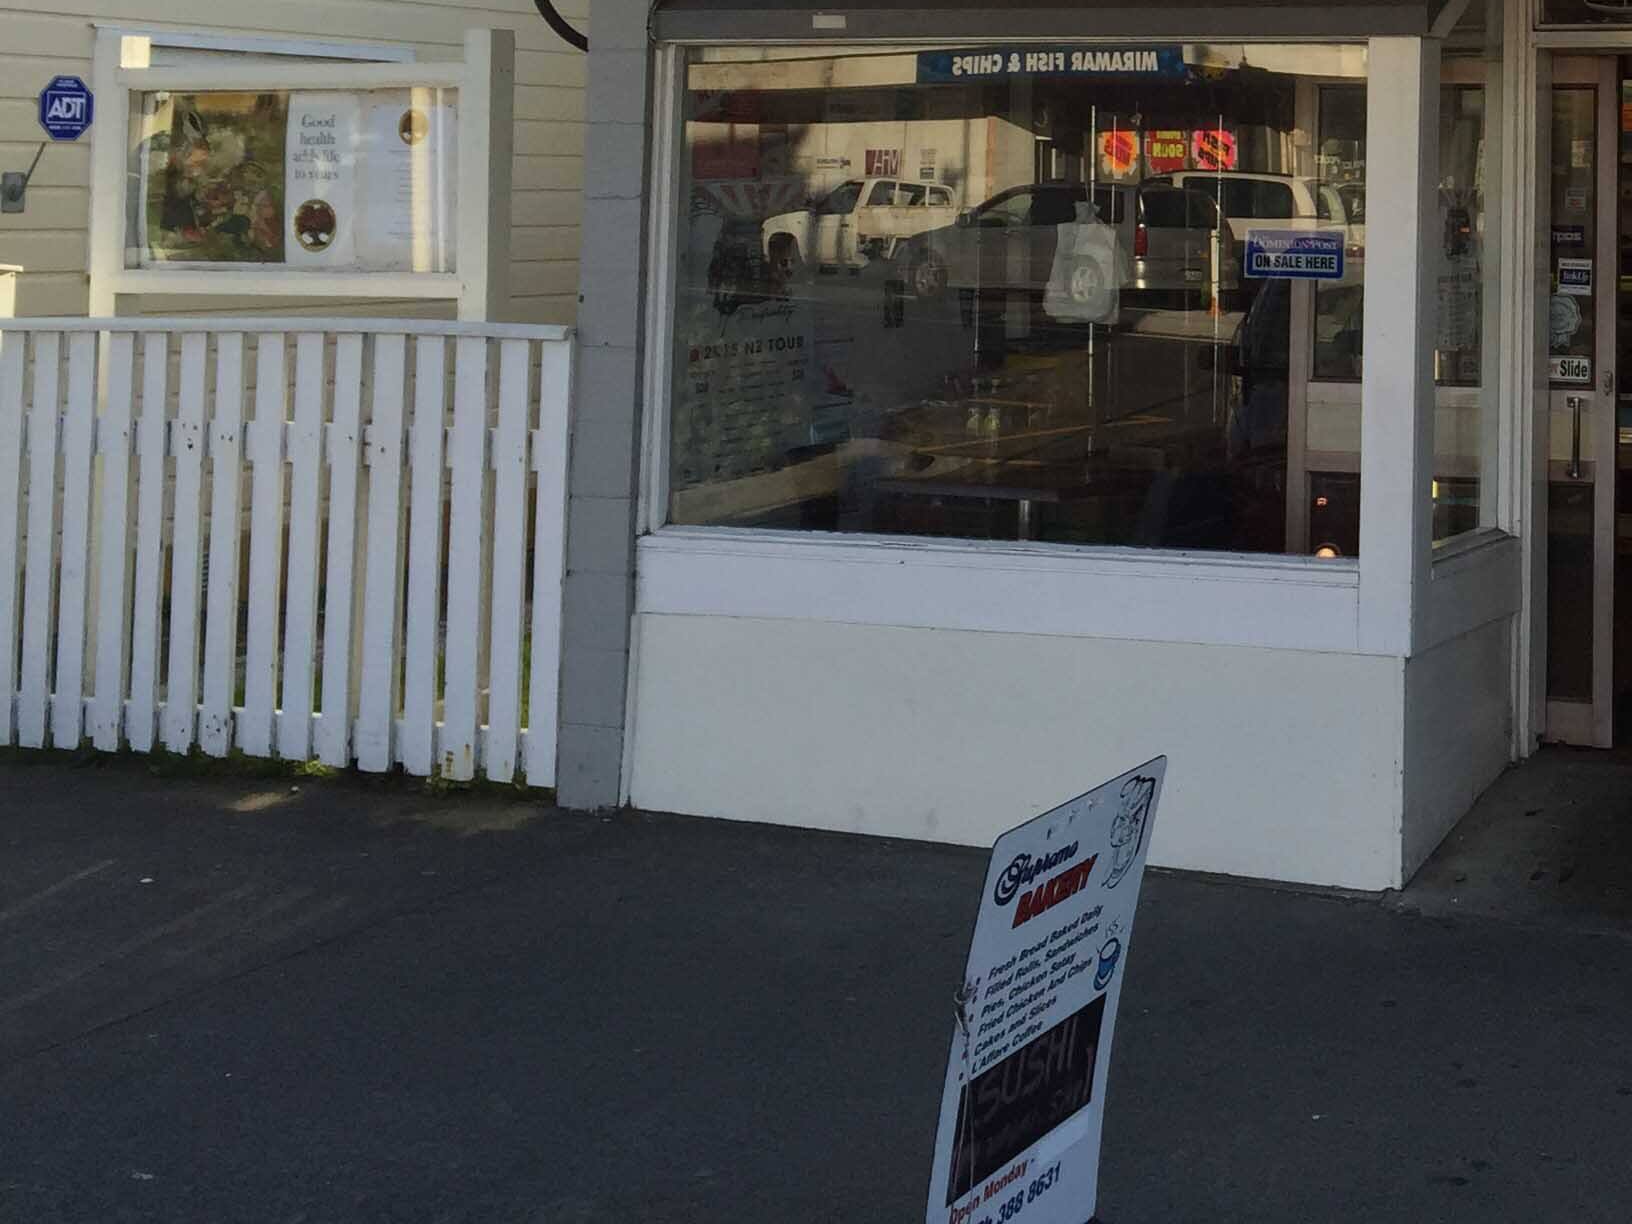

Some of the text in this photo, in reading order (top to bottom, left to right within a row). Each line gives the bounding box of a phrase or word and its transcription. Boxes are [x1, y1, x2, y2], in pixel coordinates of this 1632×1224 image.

[48, 97, 86, 119] ADT
[301, 114, 336, 128] Good
[299, 132, 336, 146] health
[1253, 235, 1337, 250] DOMINION POST
[1255, 255, 1335, 270] ON SALE HERE
[1559, 359, 1587, 378] Slide
[1012, 853, 1099, 930] BAKERY
[984, 976, 1013, 1000] Filled
[1045, 923, 1099, 963] Sandwiches
[988, 904, 1104, 981] Fresh Bread Baked Daily
[1009, 970, 1048, 998] Chicken
[1050, 953, 1077, 976] Satay
[977, 957, 1093, 1036] Fried Chicken And Chips
[974, 995, 1057, 1056] Cakes and Slices
[1012, 1021, 1044, 1046] Coffee
[977, 1016, 1077, 1122] SUSHI
[984, 1160, 1028, 1197] Monday
[996, 1161, 1062, 1224] 388 8631
